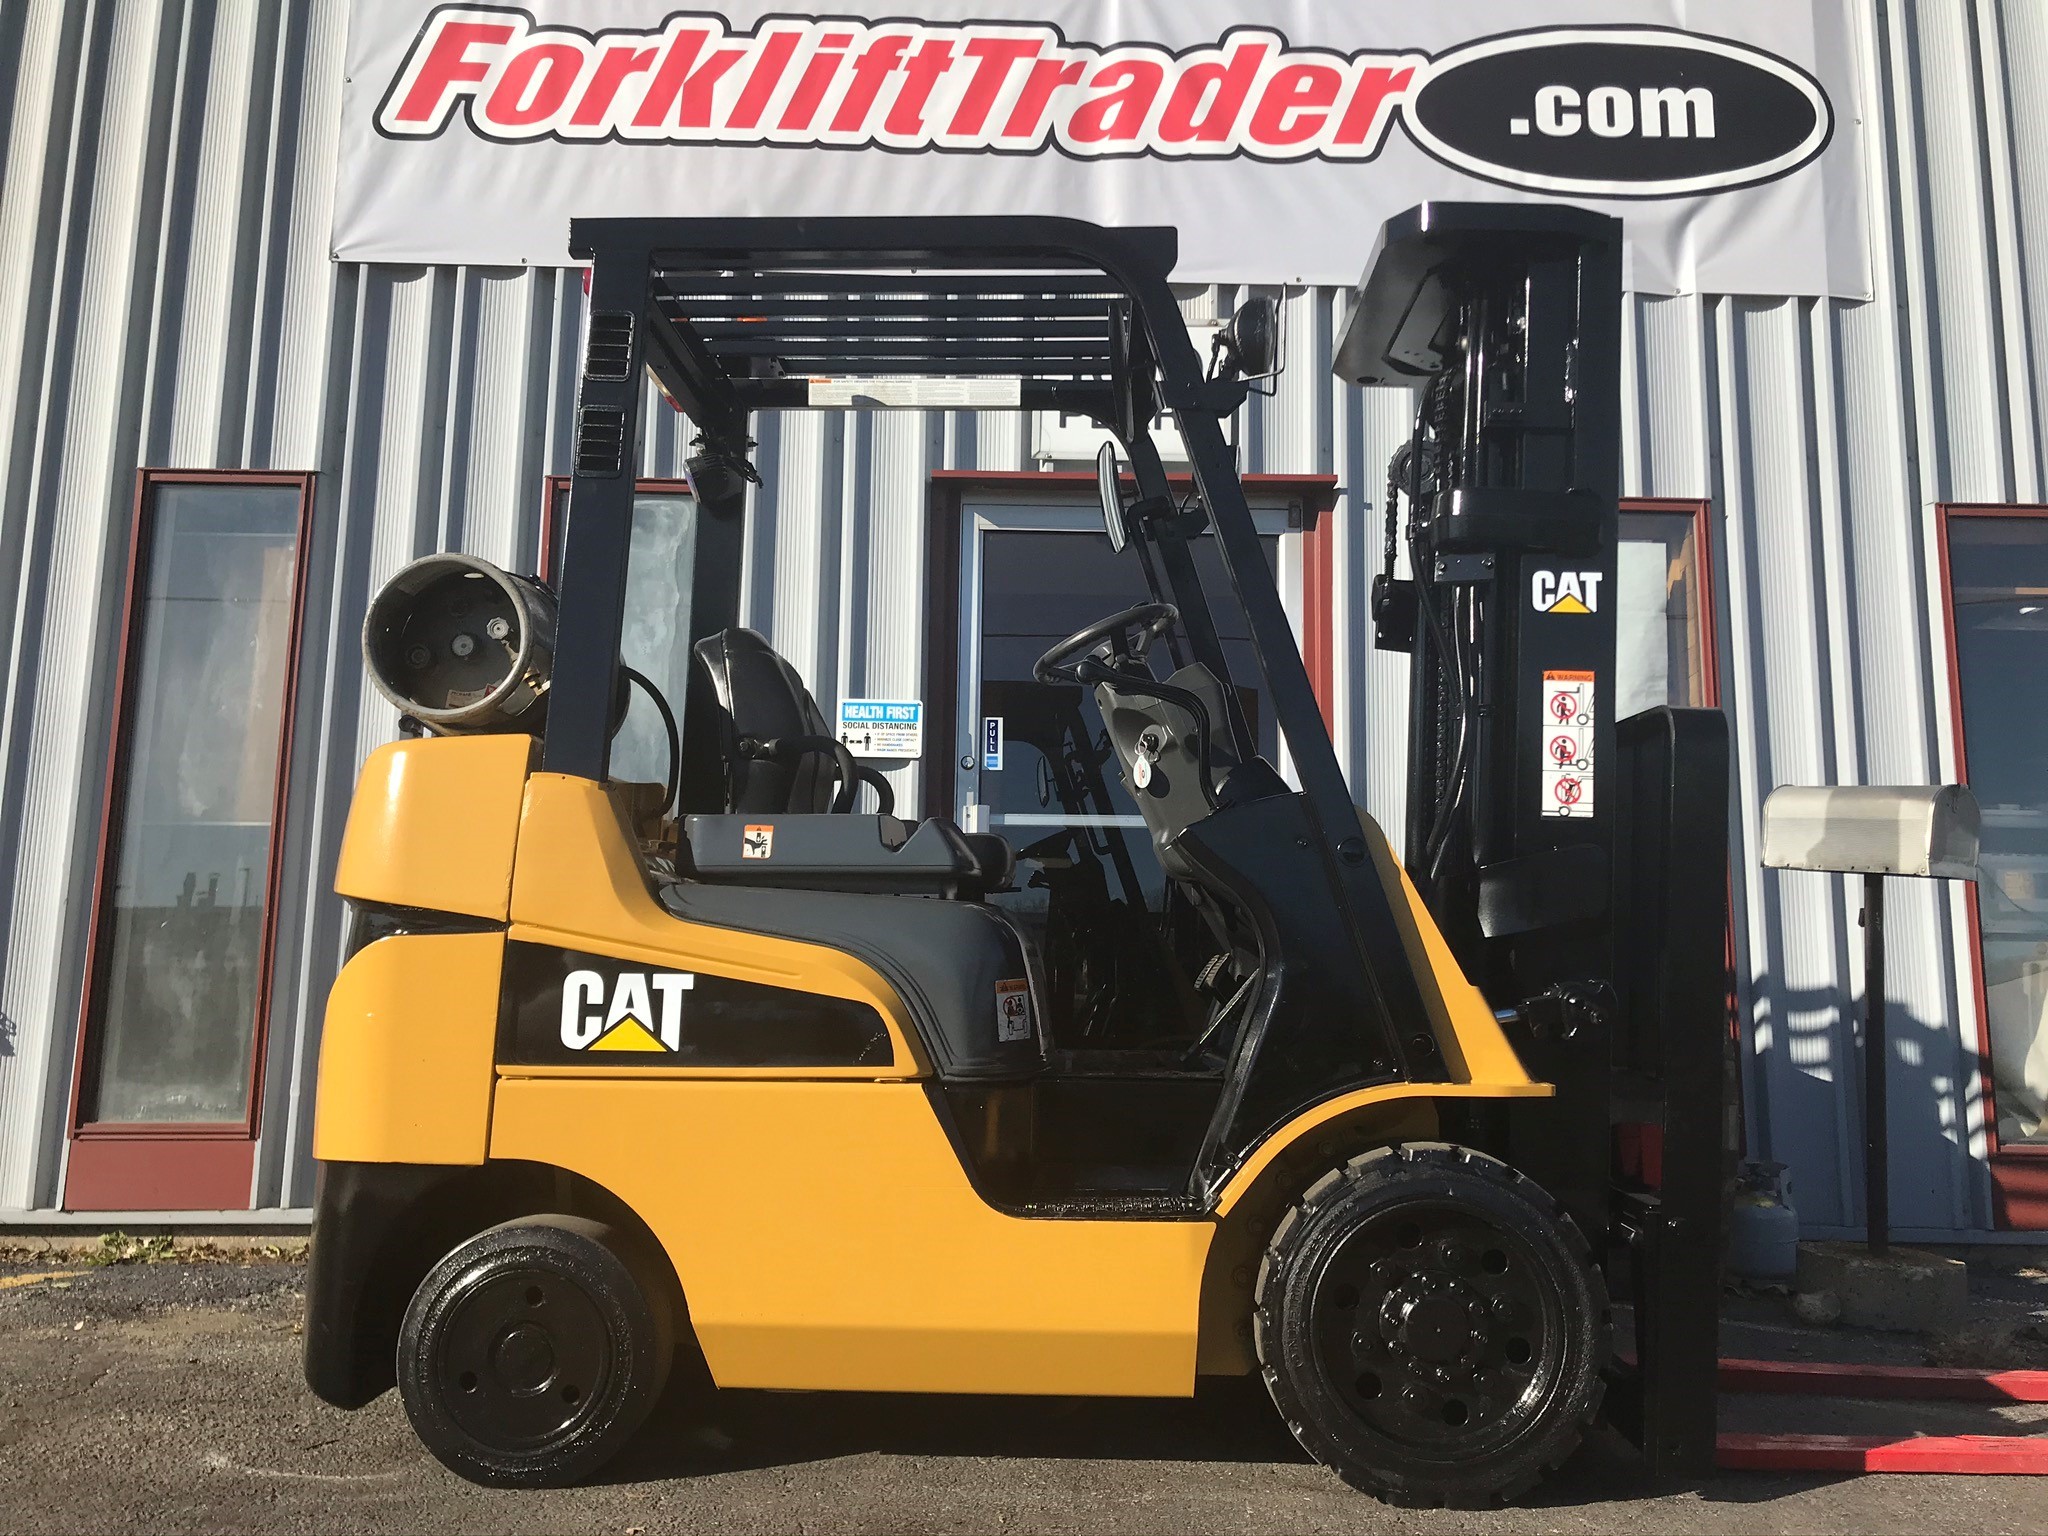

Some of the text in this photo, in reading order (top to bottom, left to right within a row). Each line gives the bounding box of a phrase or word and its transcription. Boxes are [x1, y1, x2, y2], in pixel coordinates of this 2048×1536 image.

[397, 21, 1716, 146] ForkliftTrader .com
[1532, 570, 1603, 613] CAT
[842, 721, 917, 731] SOCIAL DISTANCING
[844, 705, 916, 720] HEALTH FIRST
[560, 969, 695, 1052] CAT
